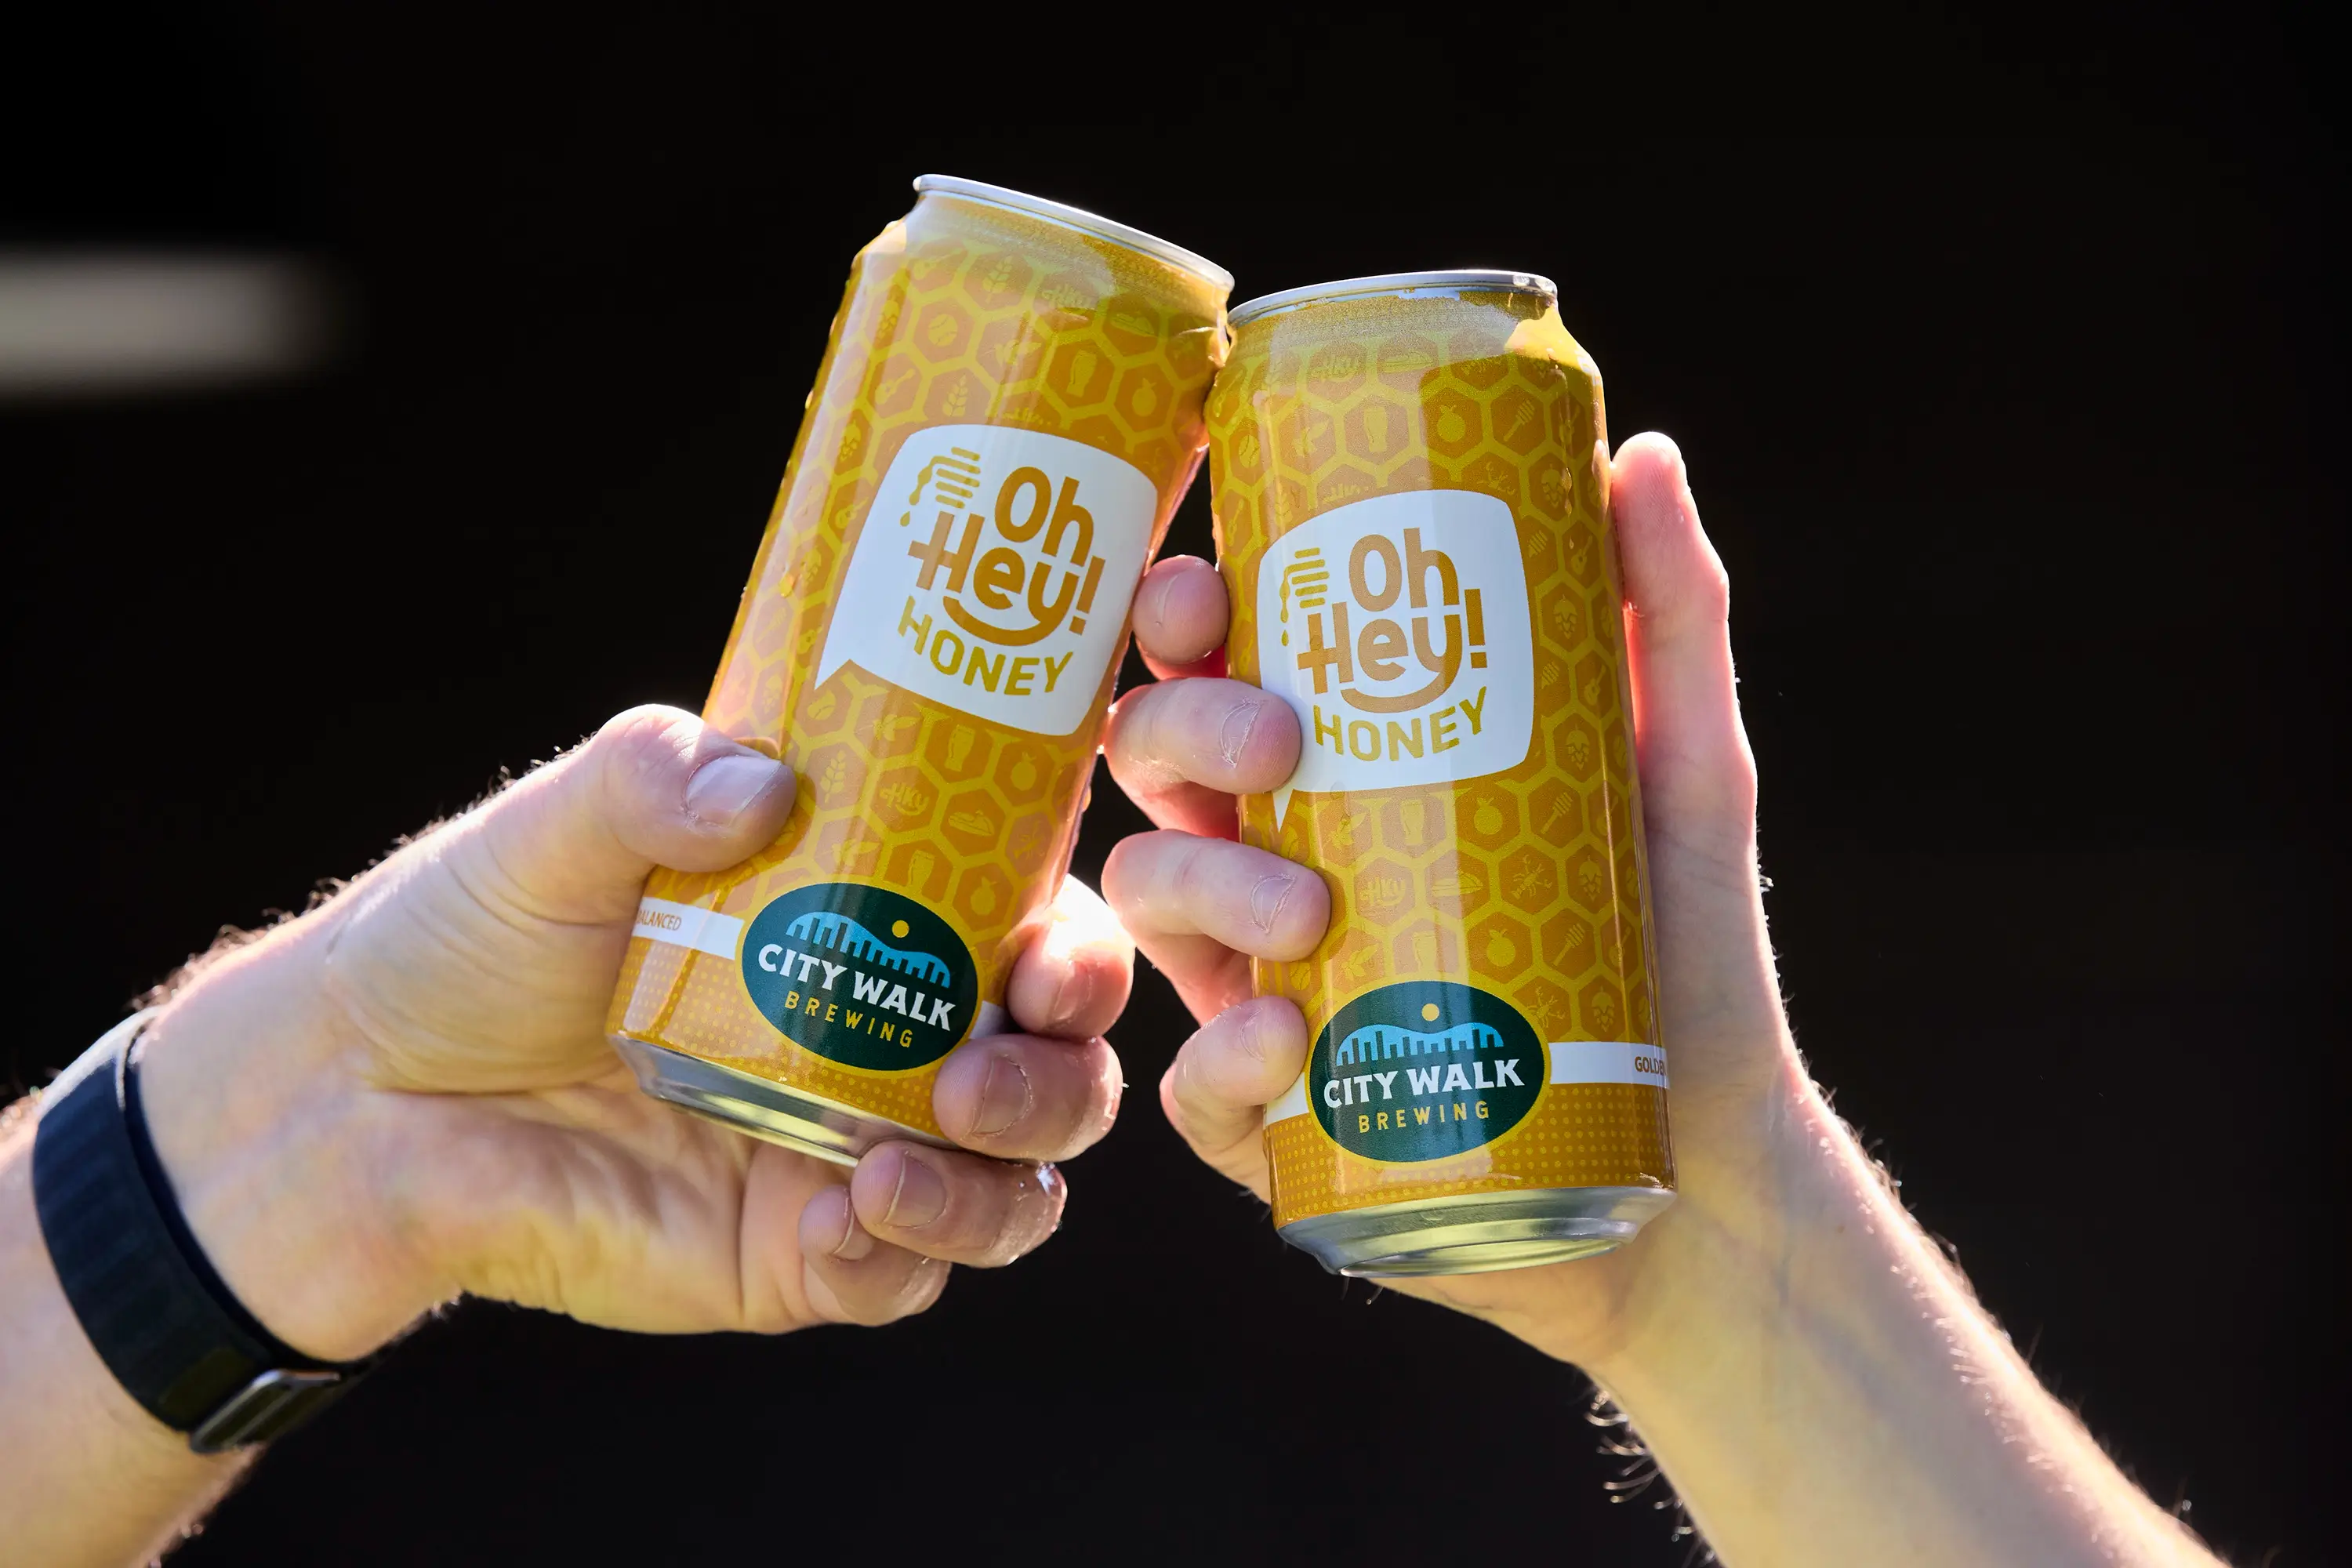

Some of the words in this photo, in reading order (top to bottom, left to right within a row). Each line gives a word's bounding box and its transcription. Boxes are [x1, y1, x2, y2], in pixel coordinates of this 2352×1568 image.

[994, 466, 1094, 567] Oh
[908, 510, 1105, 646] Hey!
[1348, 527, 1460, 612] Oh
[898, 595, 1073, 696] HONEY
[1297, 588, 1487, 714] Hey!
[1313, 686, 1487, 762] HONEY
[757, 943, 848, 990] CITY
[854, 971, 956, 1032] WALK
[784, 990, 914, 1049] BREWING
[1323, 1070, 1399, 1109] CITY
[1406, 1058, 1525, 1098] WALK
[1635, 1056, 1667, 1076] GOLDE
[1358, 1100, 1489, 1134] BREWING
